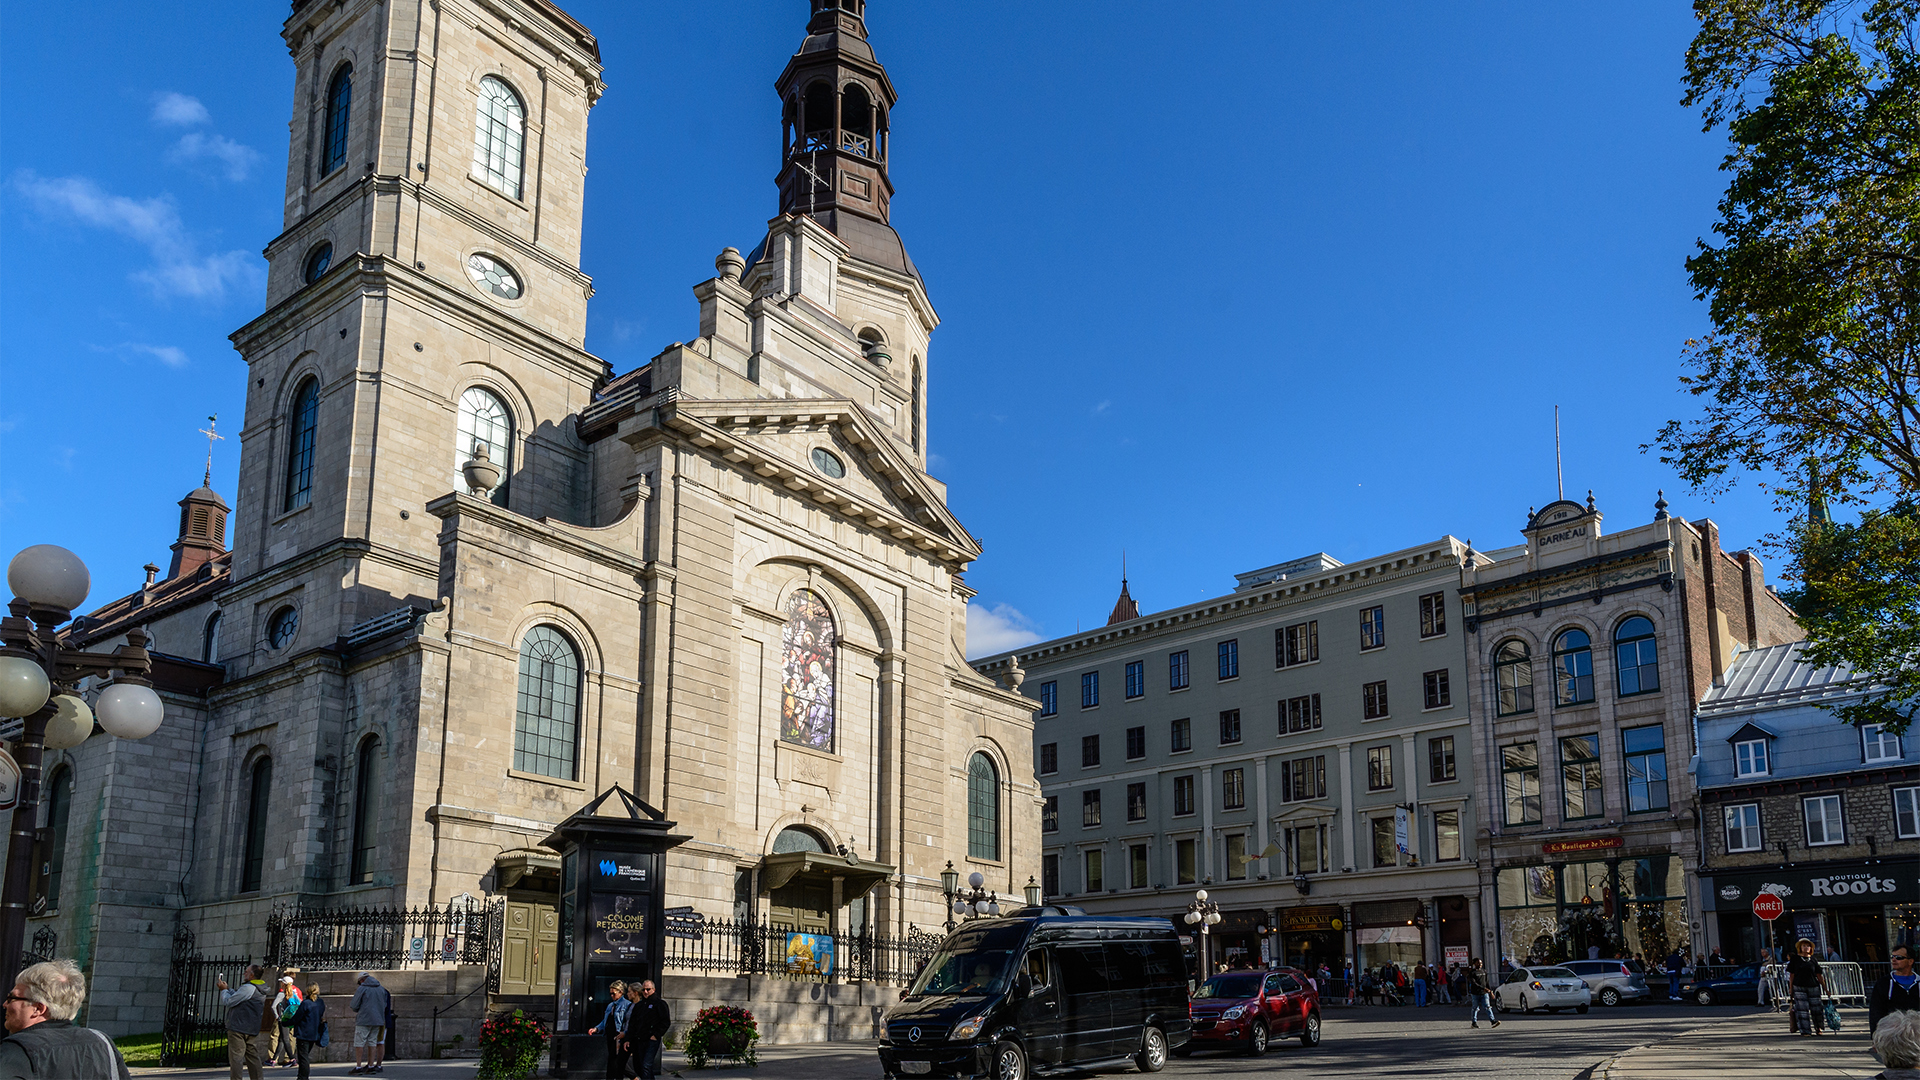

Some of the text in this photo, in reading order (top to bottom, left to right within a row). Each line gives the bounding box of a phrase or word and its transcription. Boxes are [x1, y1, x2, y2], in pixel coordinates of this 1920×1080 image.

[1540, 527, 1586, 546] GARNEAU
[1561, 842, 1590, 851] Boutique
[1829, 873, 1871, 881] BOUTIQUE
[1810, 876, 1897, 896] Roots
[1755, 901, 1781, 911] ARRÊT
[607, 914, 644, 922] COLONIE
[596, 920, 644, 930] RETROUVÉE
